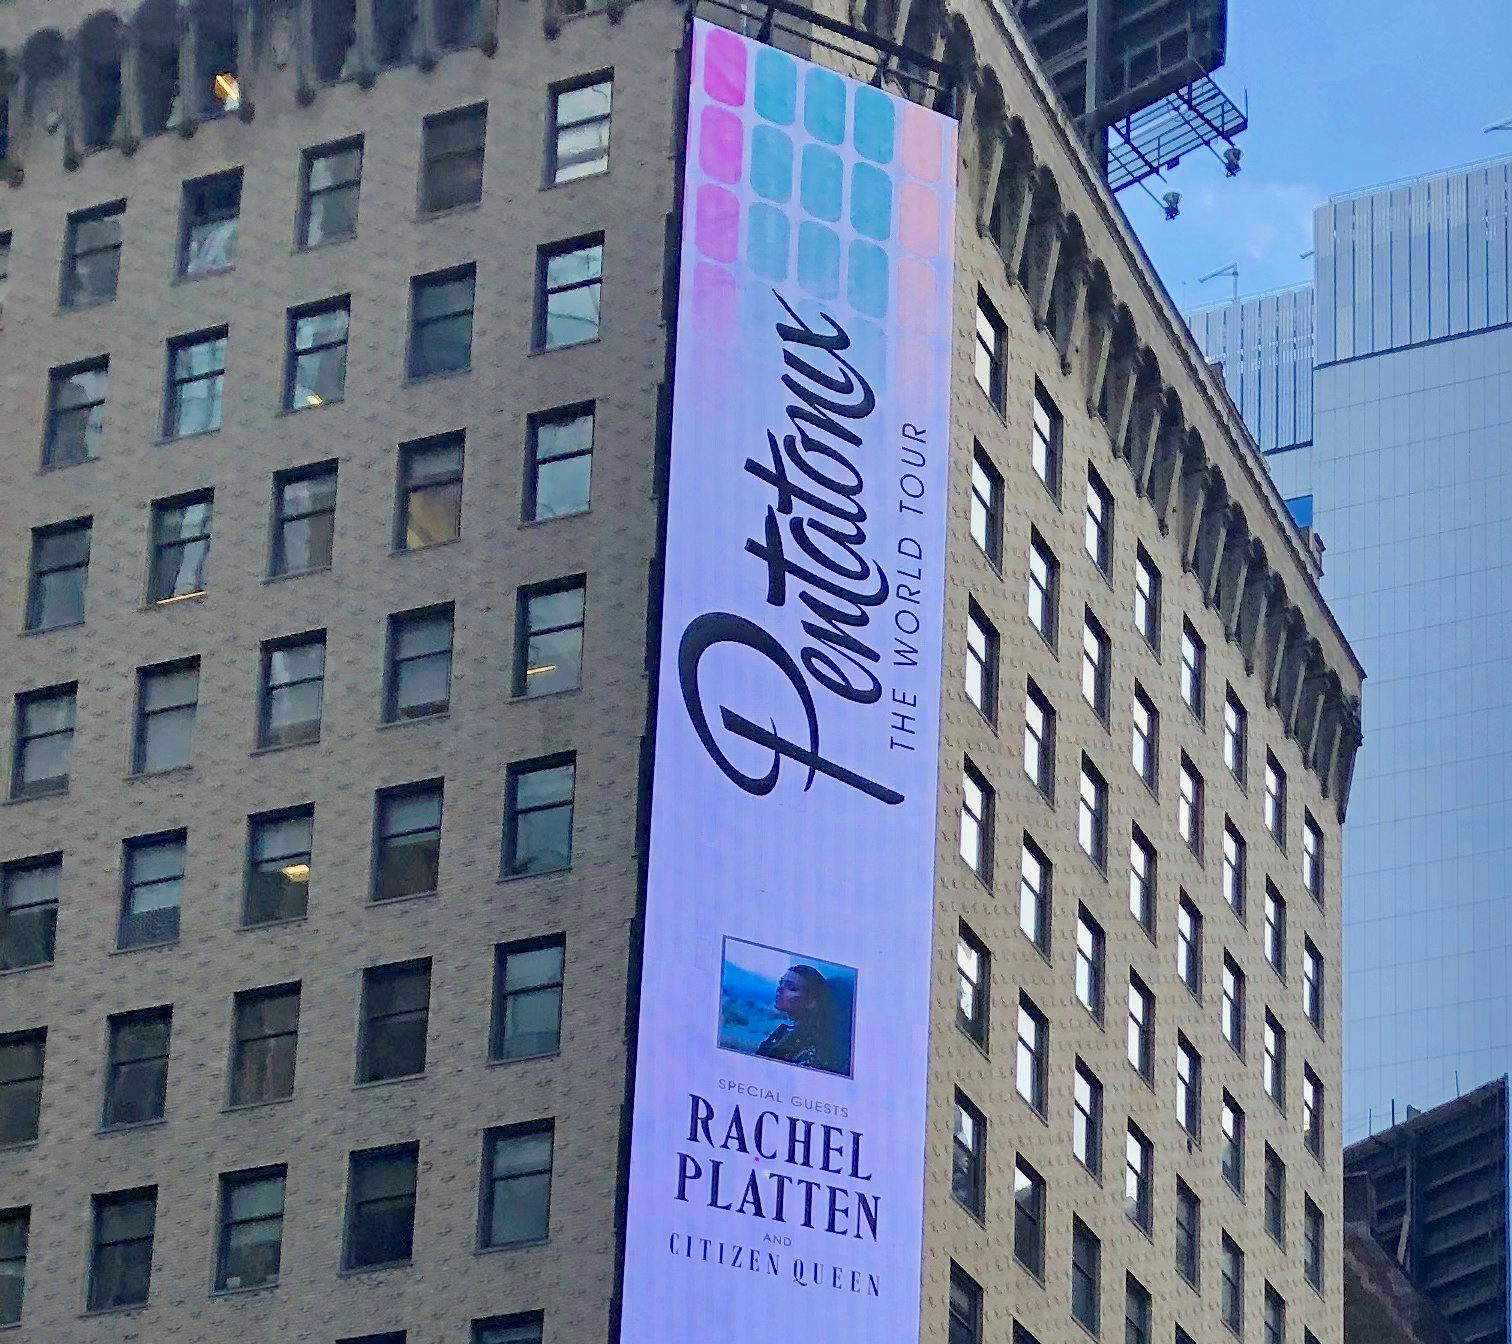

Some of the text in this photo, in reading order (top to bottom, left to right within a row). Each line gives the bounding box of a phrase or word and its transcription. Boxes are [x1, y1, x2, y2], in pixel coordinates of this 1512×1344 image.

[677, 288, 905, 805] Pentatonix
[889, 422, 928, 751] THE WORLD TOUR
[687, 1093, 873, 1182] RACHEL
[718, 1078, 849, 1118] SPECIAL GUESTS
[674, 1152, 882, 1243] PLATTEN
[763, 1232, 793, 1248] AND
[669, 1232, 881, 1297] CITIZEN QUEEN
